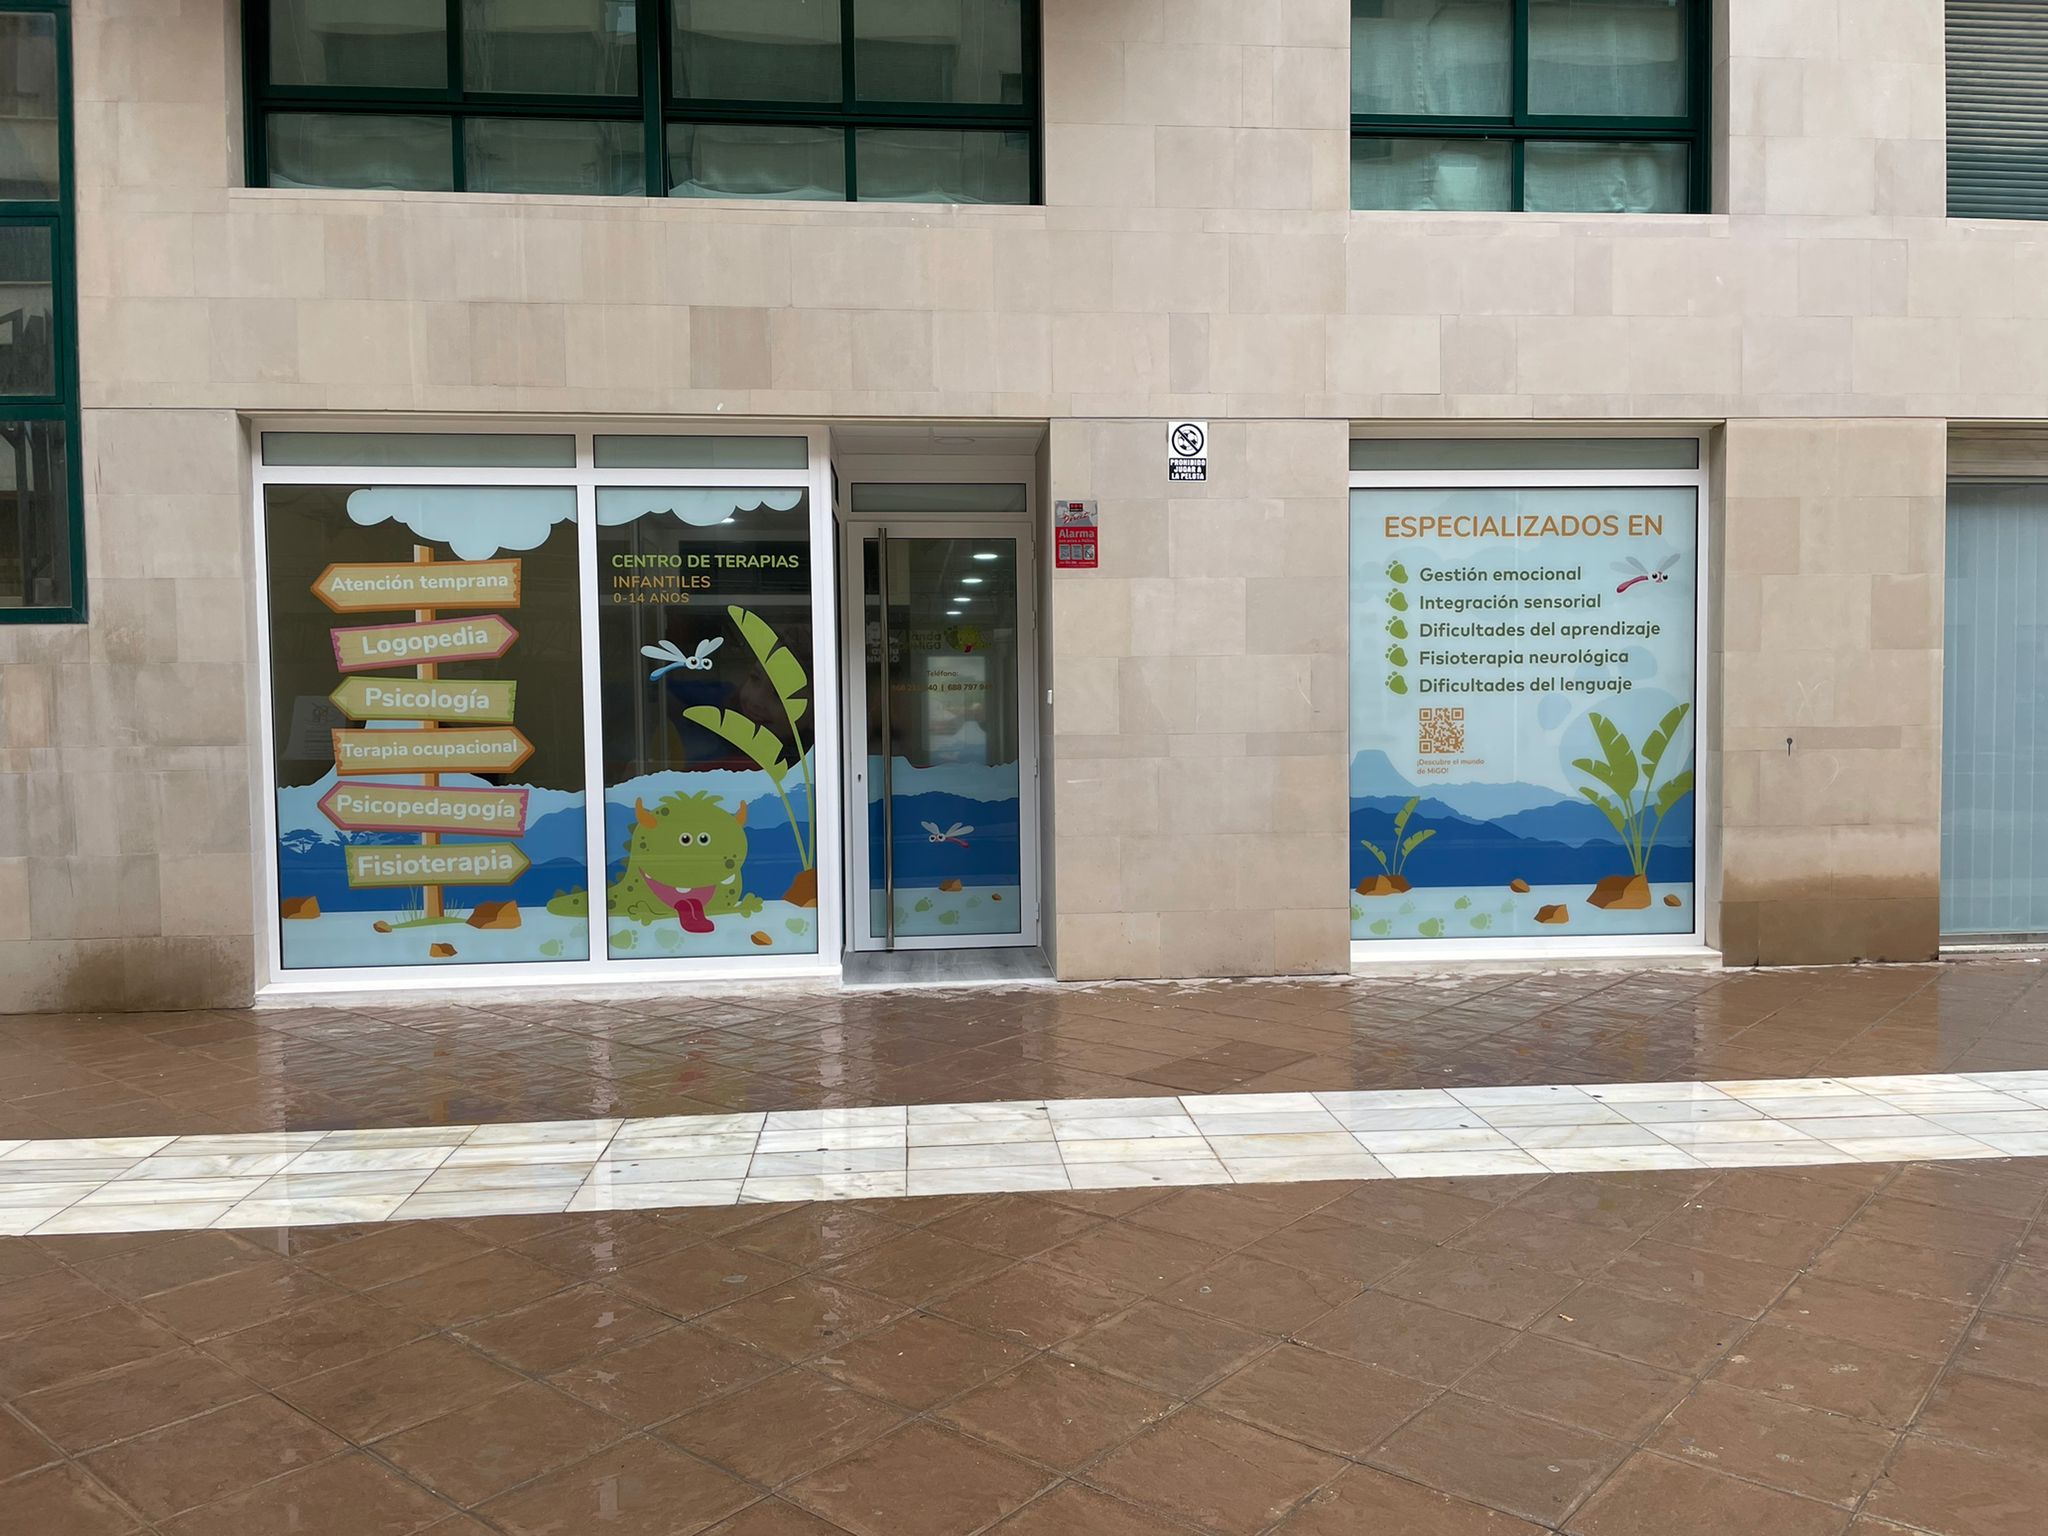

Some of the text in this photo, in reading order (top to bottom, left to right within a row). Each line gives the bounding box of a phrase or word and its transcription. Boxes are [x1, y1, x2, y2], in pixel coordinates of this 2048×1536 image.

[1058, 529, 1095, 538] Alarma
[1383, 515, 1663, 538] ESPECIALIZADOS EN
[612, 554, 799, 568] CENTRO DE TERAPIAS
[330, 574, 508, 592] Atención temprana
[613, 575, 711, 589] INFANTILES
[1419, 566, 1582, 582] Gestión emocional
[613, 589, 690, 603] 0-14 AÑOS
[1419, 593, 1602, 613] Integración sensorial
[1419, 621, 1661, 639] Dificultades del aprendizaje
[361, 625, 488, 656] Logopedia
[1419, 648, 1630, 668] Fisioterapia neurológica
[963, 683, 978, 691] 797
[1419, 677, 1633, 694] Dificultades del lenguaje
[365, 687, 490, 713] Psicología
[342, 739, 518, 759] Terapia ocupacional
[336, 794, 516, 821] Psicopedagogía
[358, 849, 513, 877] Fisioterapia
